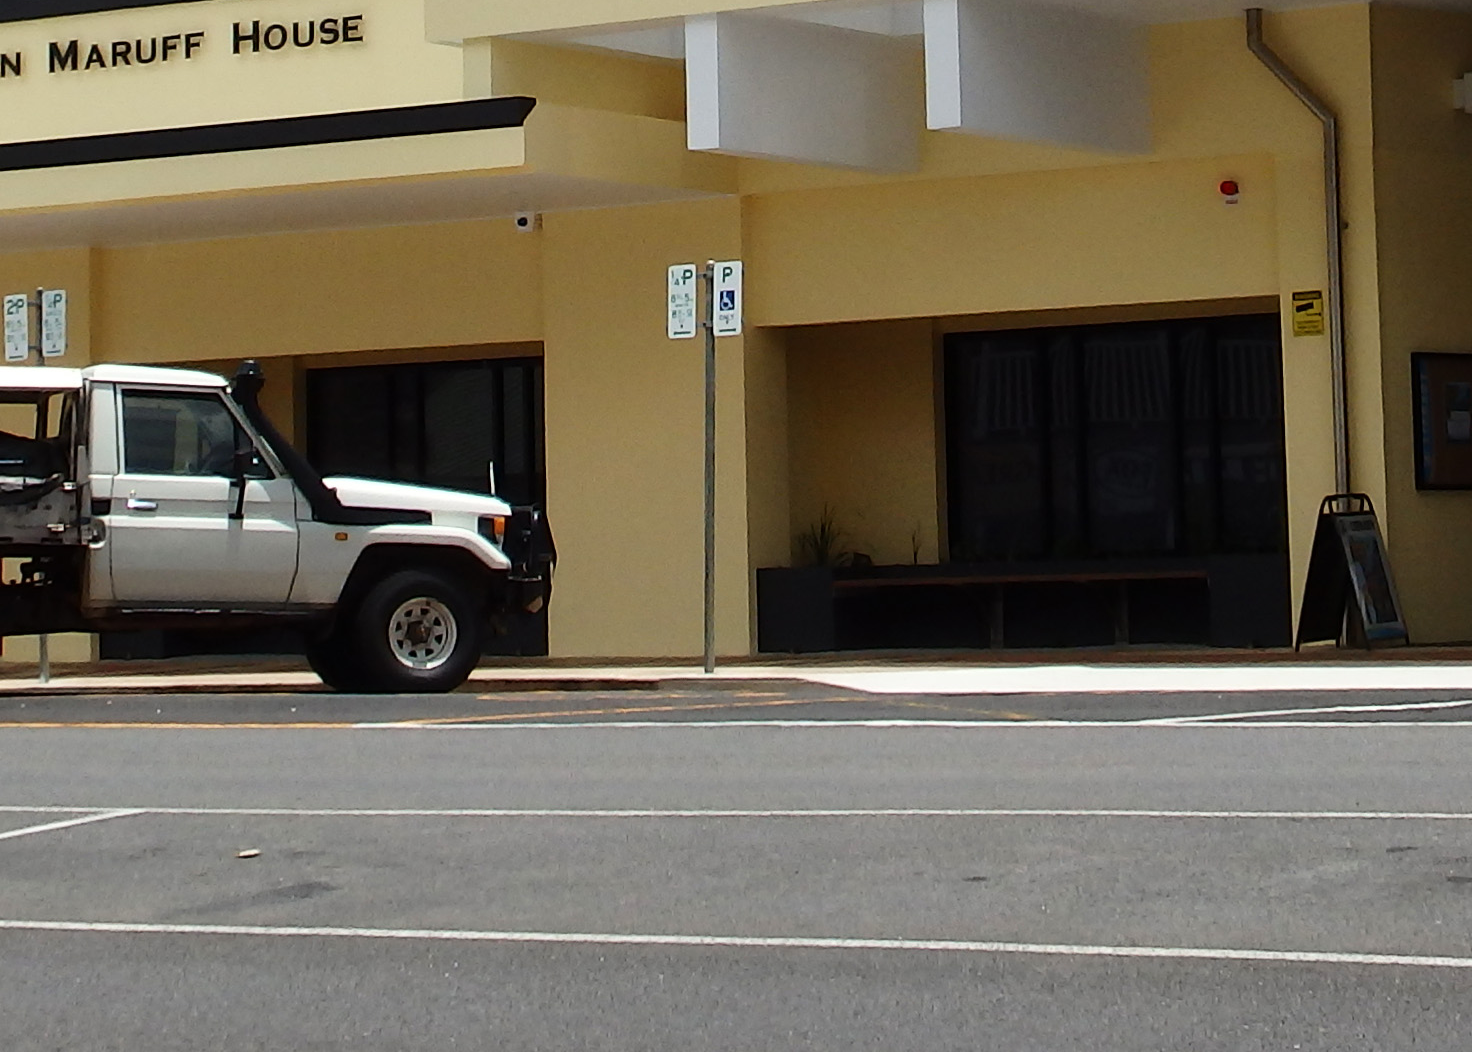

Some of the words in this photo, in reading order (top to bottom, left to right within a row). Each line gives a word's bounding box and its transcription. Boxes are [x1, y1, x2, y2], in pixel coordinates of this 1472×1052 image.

[48, 31, 205, 74] MARUFF
[232, 14, 364, 55] HOUSE
[722, 266, 733, 283] P
[6, 298, 25, 315] 2P
